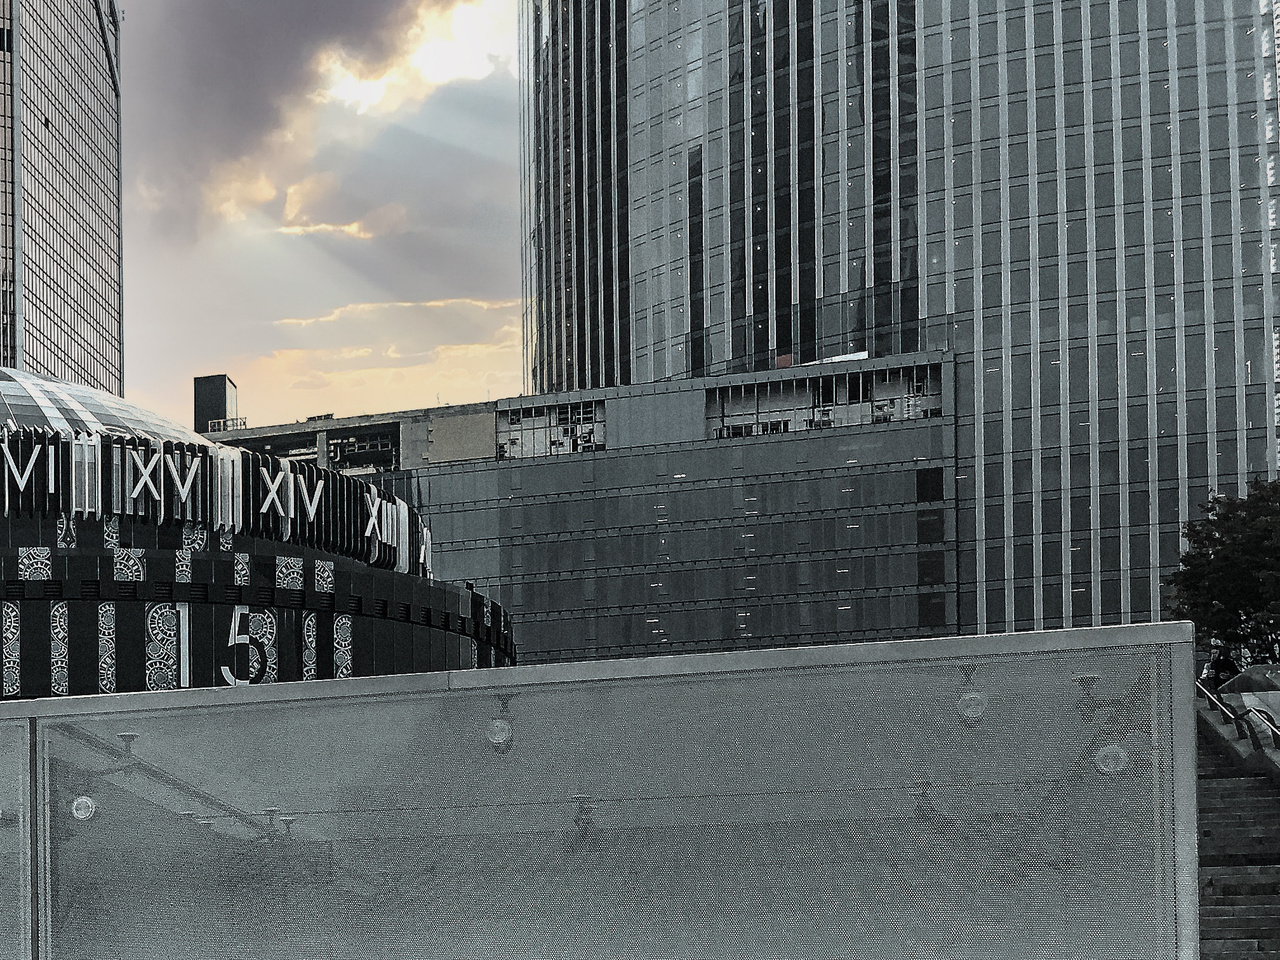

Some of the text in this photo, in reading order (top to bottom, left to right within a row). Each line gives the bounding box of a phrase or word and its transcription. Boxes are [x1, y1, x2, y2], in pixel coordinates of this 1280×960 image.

[130, 450, 201, 502] XV
[259, 467, 324, 522] XIV
[364, 492, 397, 548] XIII
